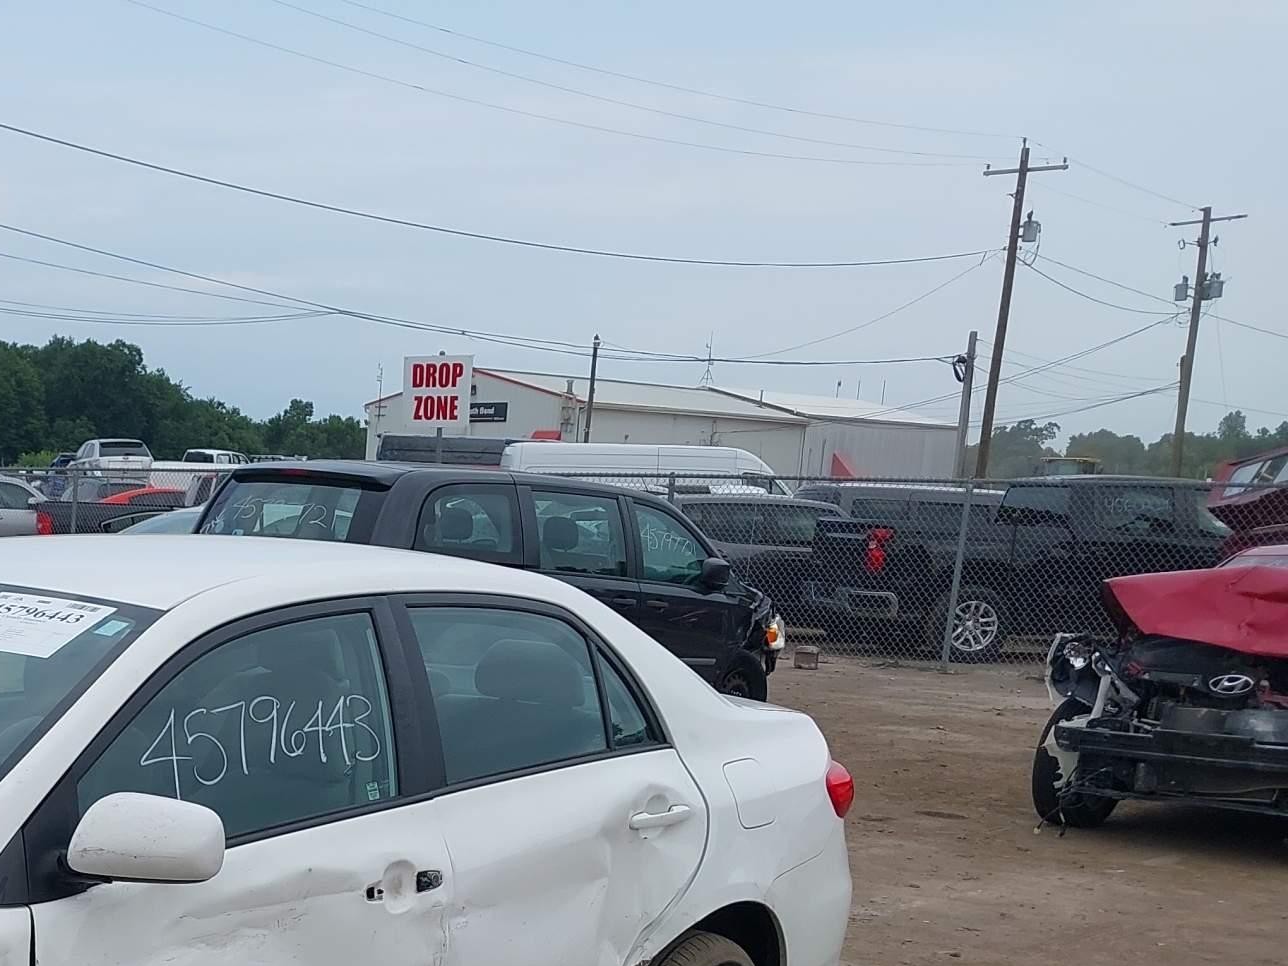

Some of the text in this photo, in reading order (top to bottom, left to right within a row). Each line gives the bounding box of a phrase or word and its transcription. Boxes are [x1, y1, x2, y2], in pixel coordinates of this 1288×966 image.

[412, 362, 464, 388] DROP
[413, 395, 459, 420] ZONE
[140, 694, 381, 800] 45796443
